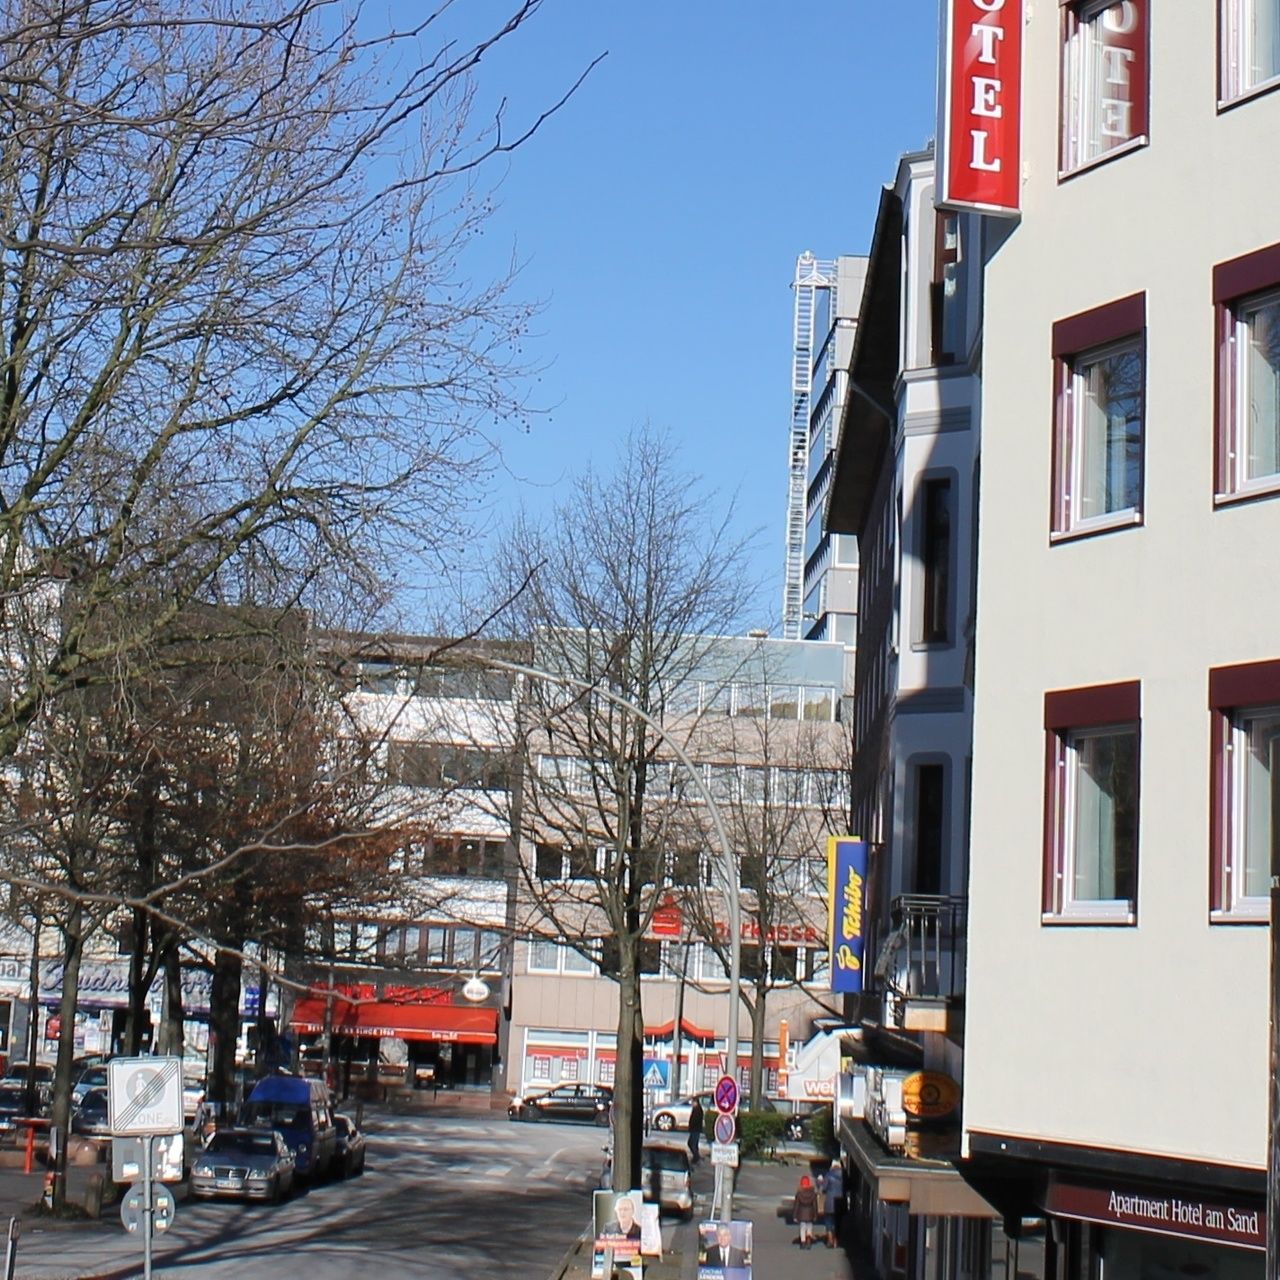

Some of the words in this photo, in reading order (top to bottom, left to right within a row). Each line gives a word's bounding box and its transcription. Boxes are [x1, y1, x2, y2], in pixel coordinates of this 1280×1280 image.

[842, 864, 863, 941] Tchibo
[710, 918, 818, 943] prkasse
[1108, 1190, 1169, 1220] Apartment
[1172, 1199, 1202, 1227] Hotel
[1206, 1209, 1224, 1230] am
[1227, 1207, 1259, 1235] Sand
